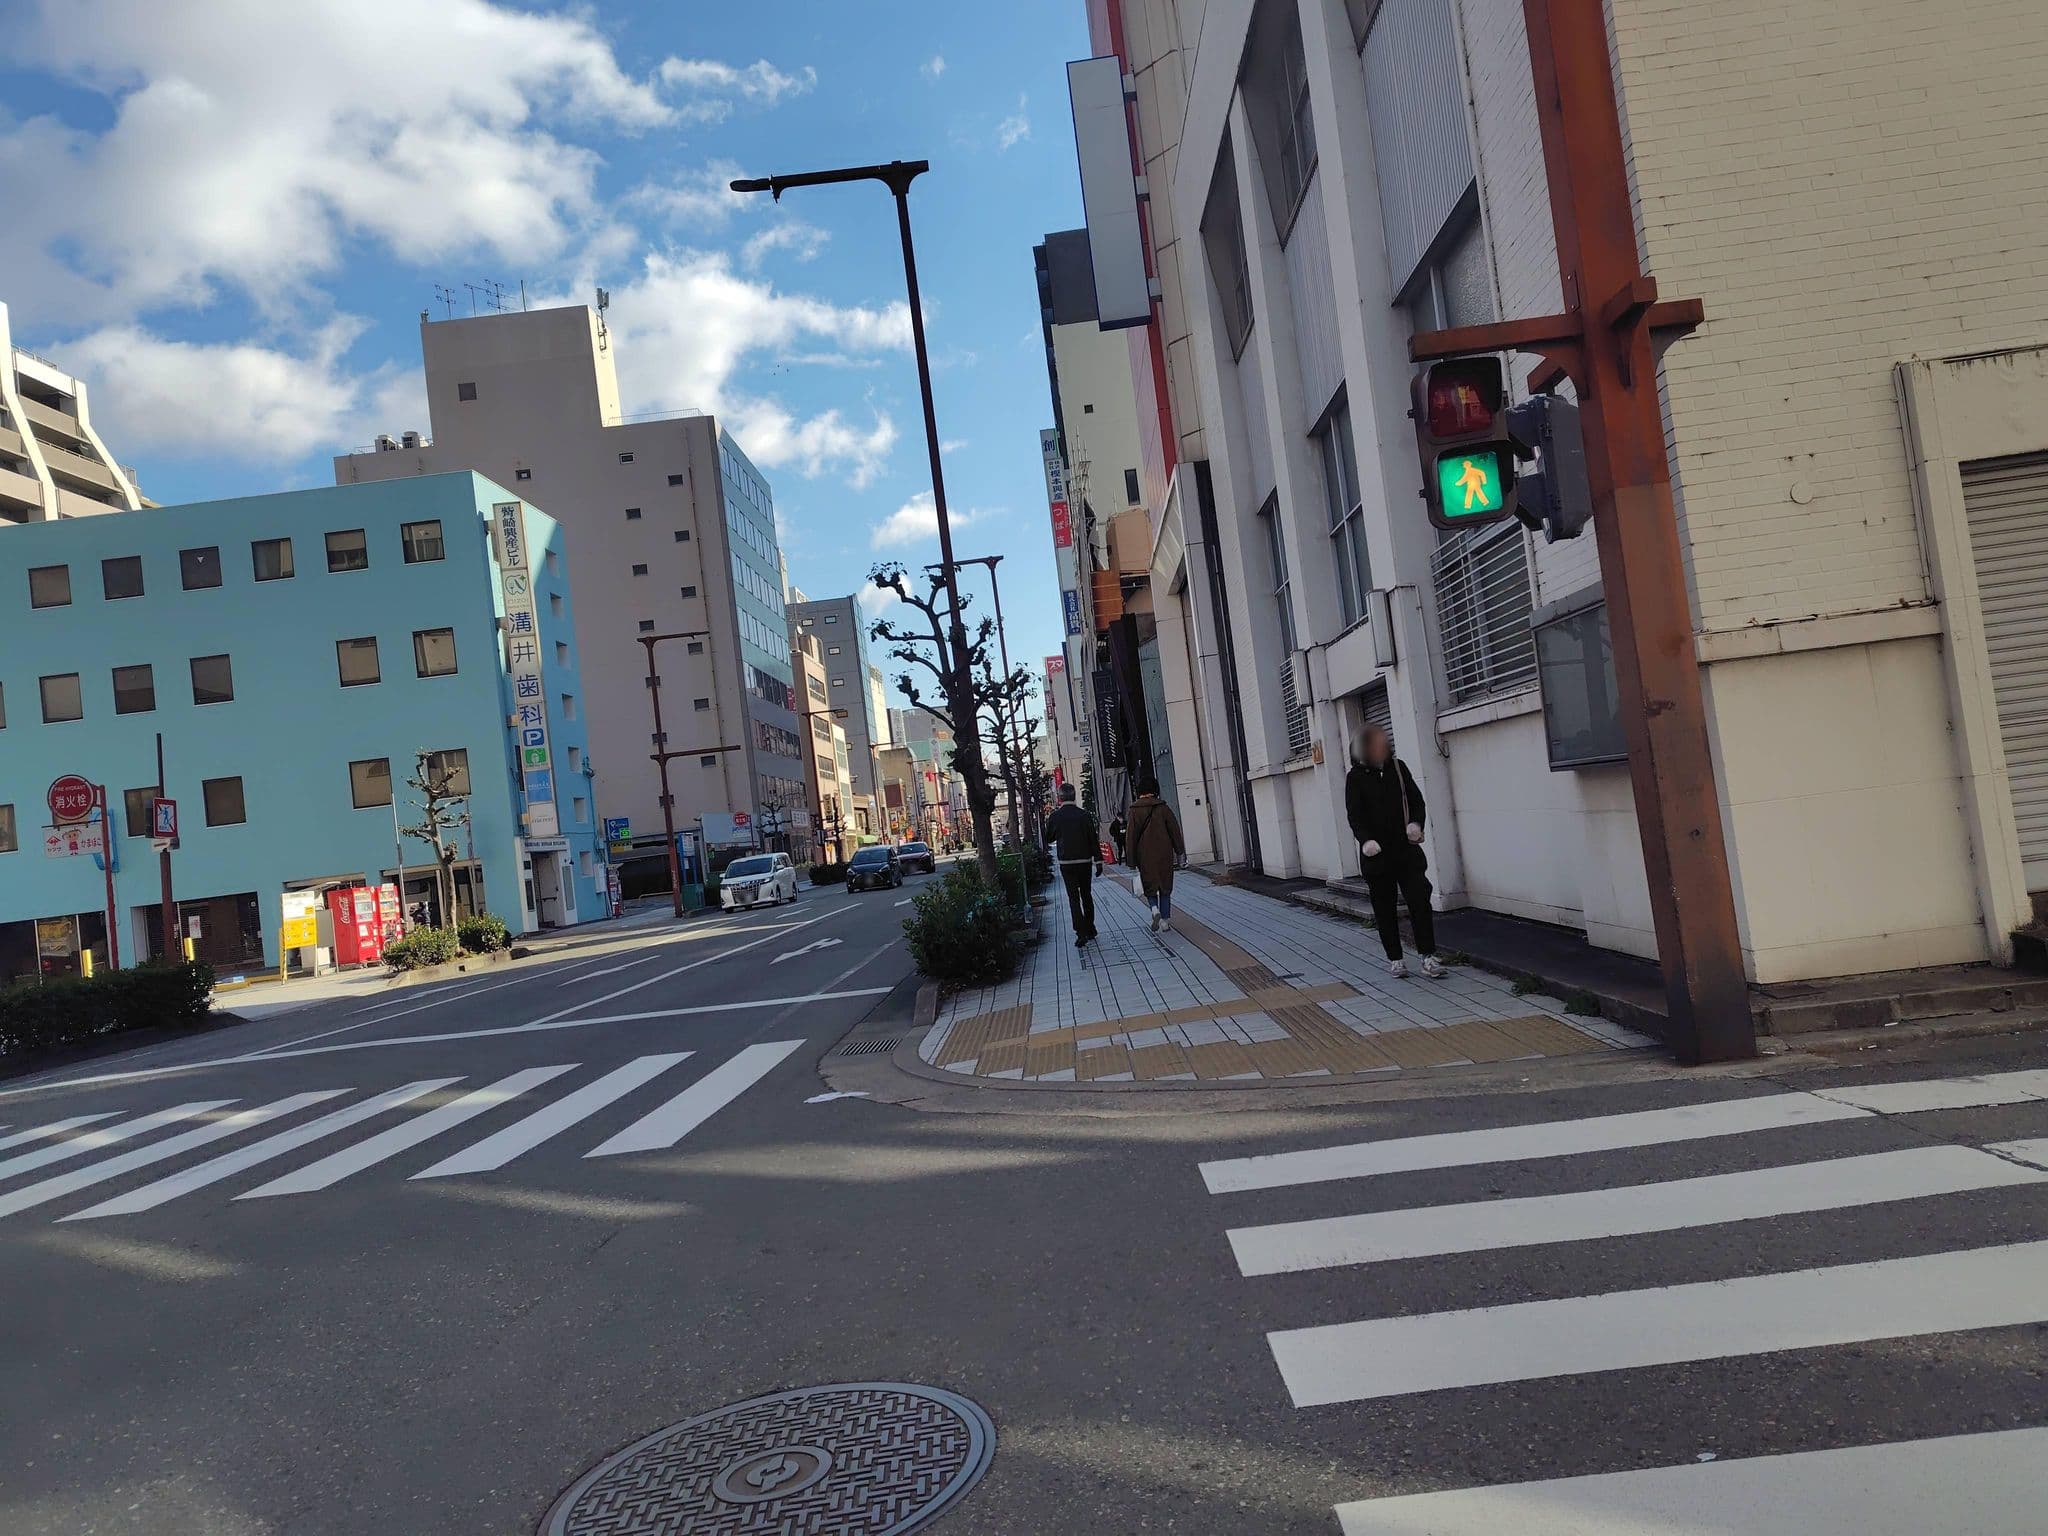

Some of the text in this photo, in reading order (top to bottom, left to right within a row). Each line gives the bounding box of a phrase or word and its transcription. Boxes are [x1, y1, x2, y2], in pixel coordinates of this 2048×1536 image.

[509, 611, 543, 727] 溝井歯科
[55, 793, 88, 809] 消火栓
